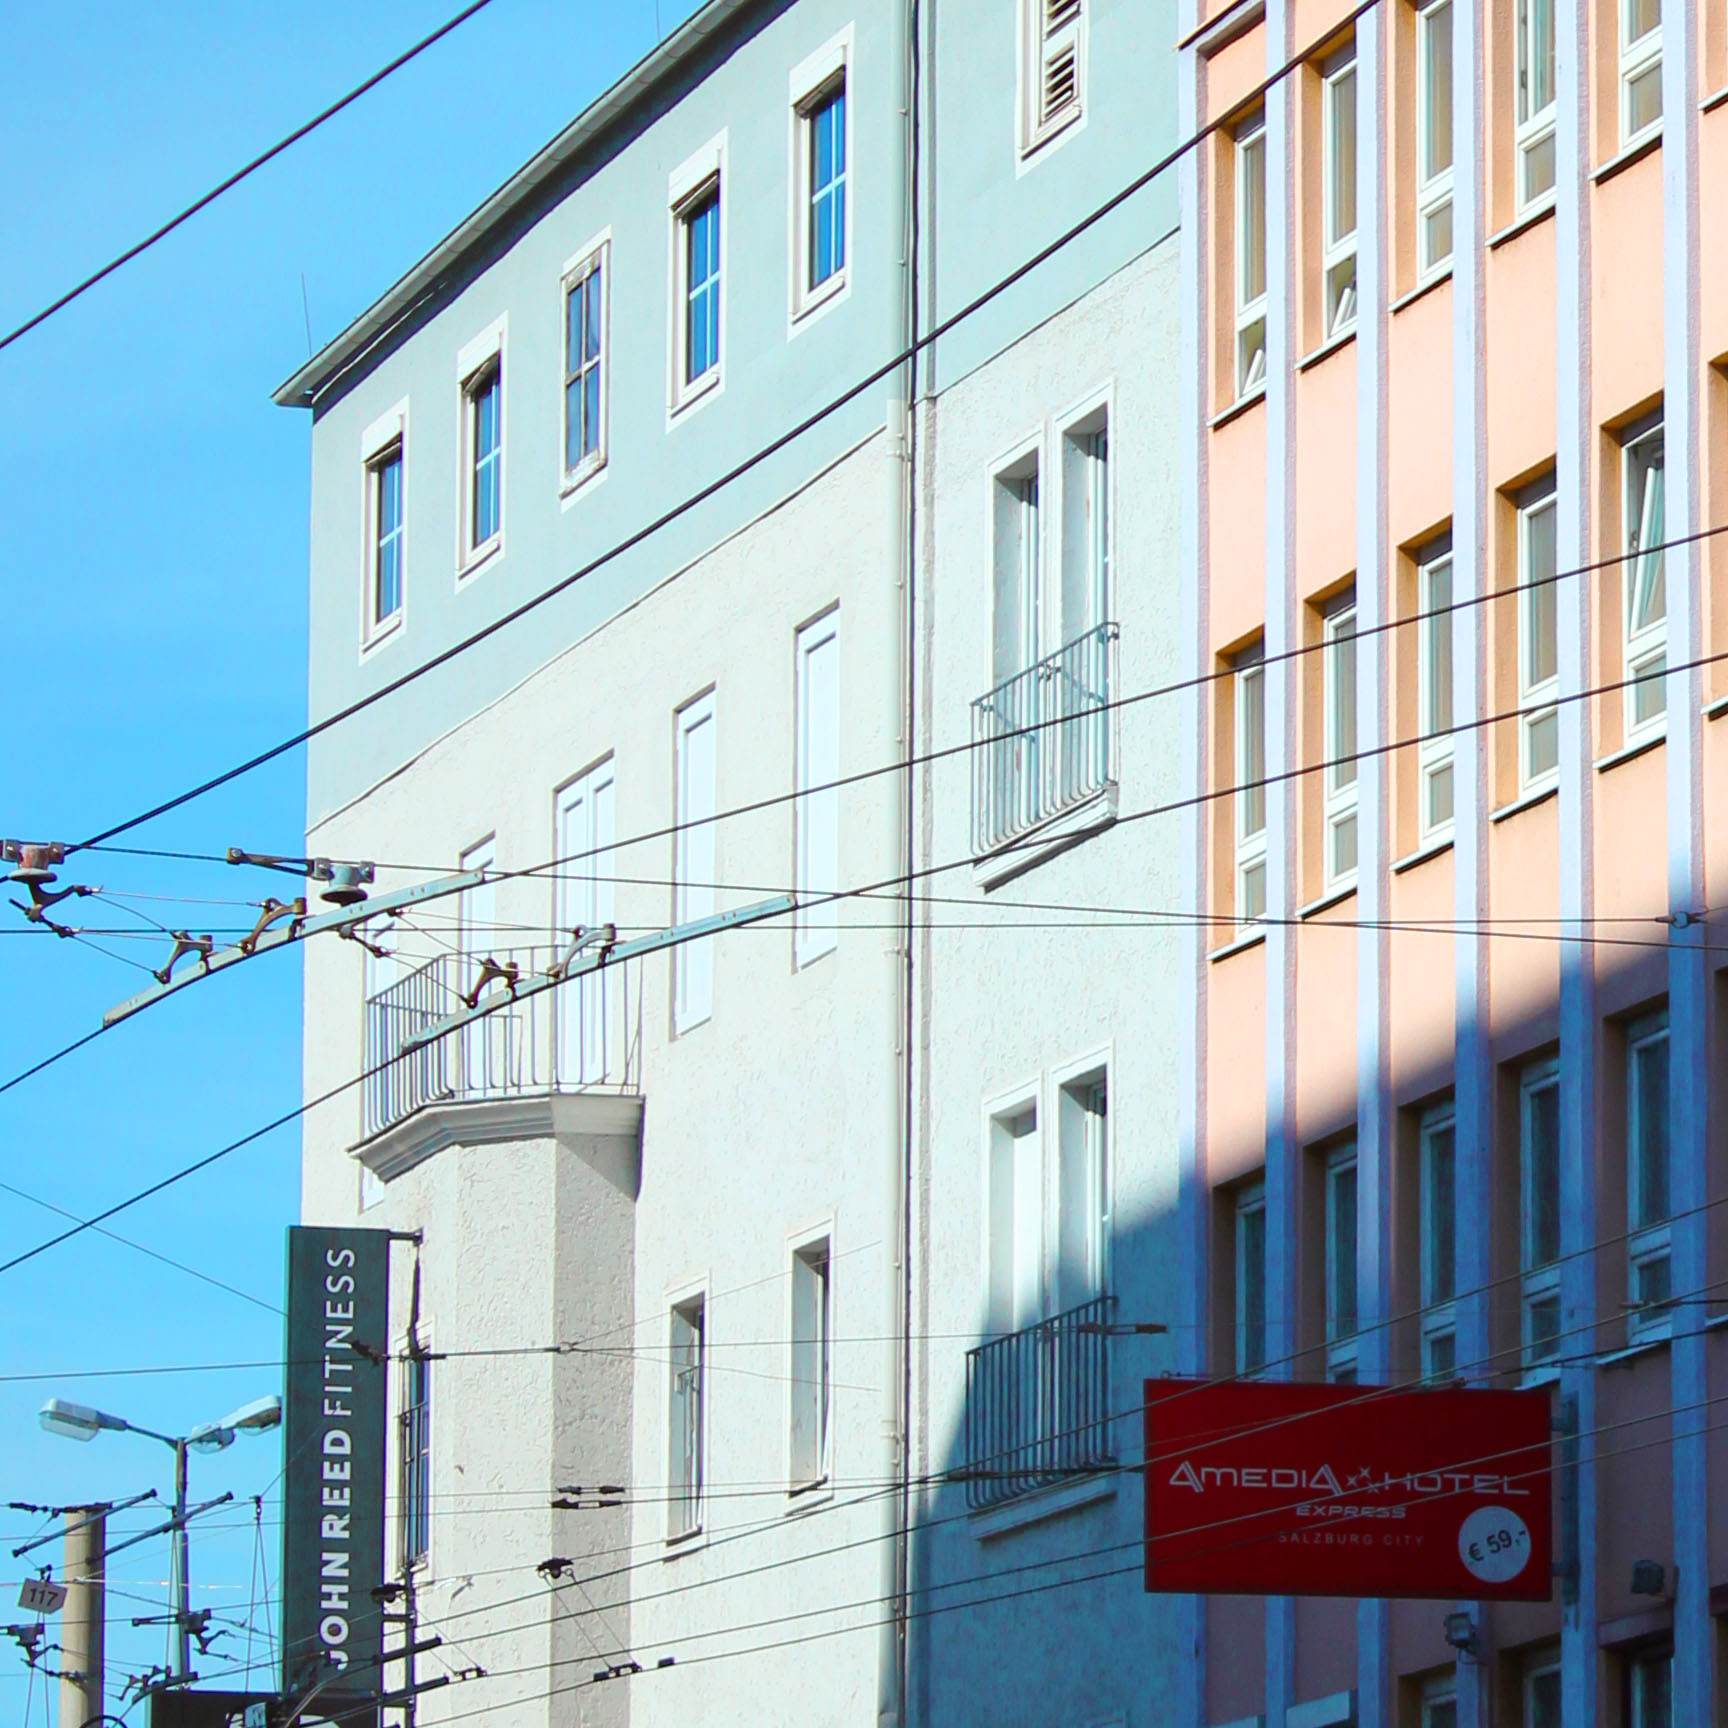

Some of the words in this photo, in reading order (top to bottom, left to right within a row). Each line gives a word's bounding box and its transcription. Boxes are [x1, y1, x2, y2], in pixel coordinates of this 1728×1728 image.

[323, 1247, 356, 1417] FITNESS
[321, 1428, 352, 1540] REED
[1384, 1471, 1531, 1496] HOTEL
[1296, 1504, 1407, 1520] EXPRESS
[1278, 1531, 1373, 1547] SALZBURG
[1381, 1533, 1424, 1548] CITY
[29, 1587, 58, 1607] 117
[319, 1552, 350, 1671] JOHN
